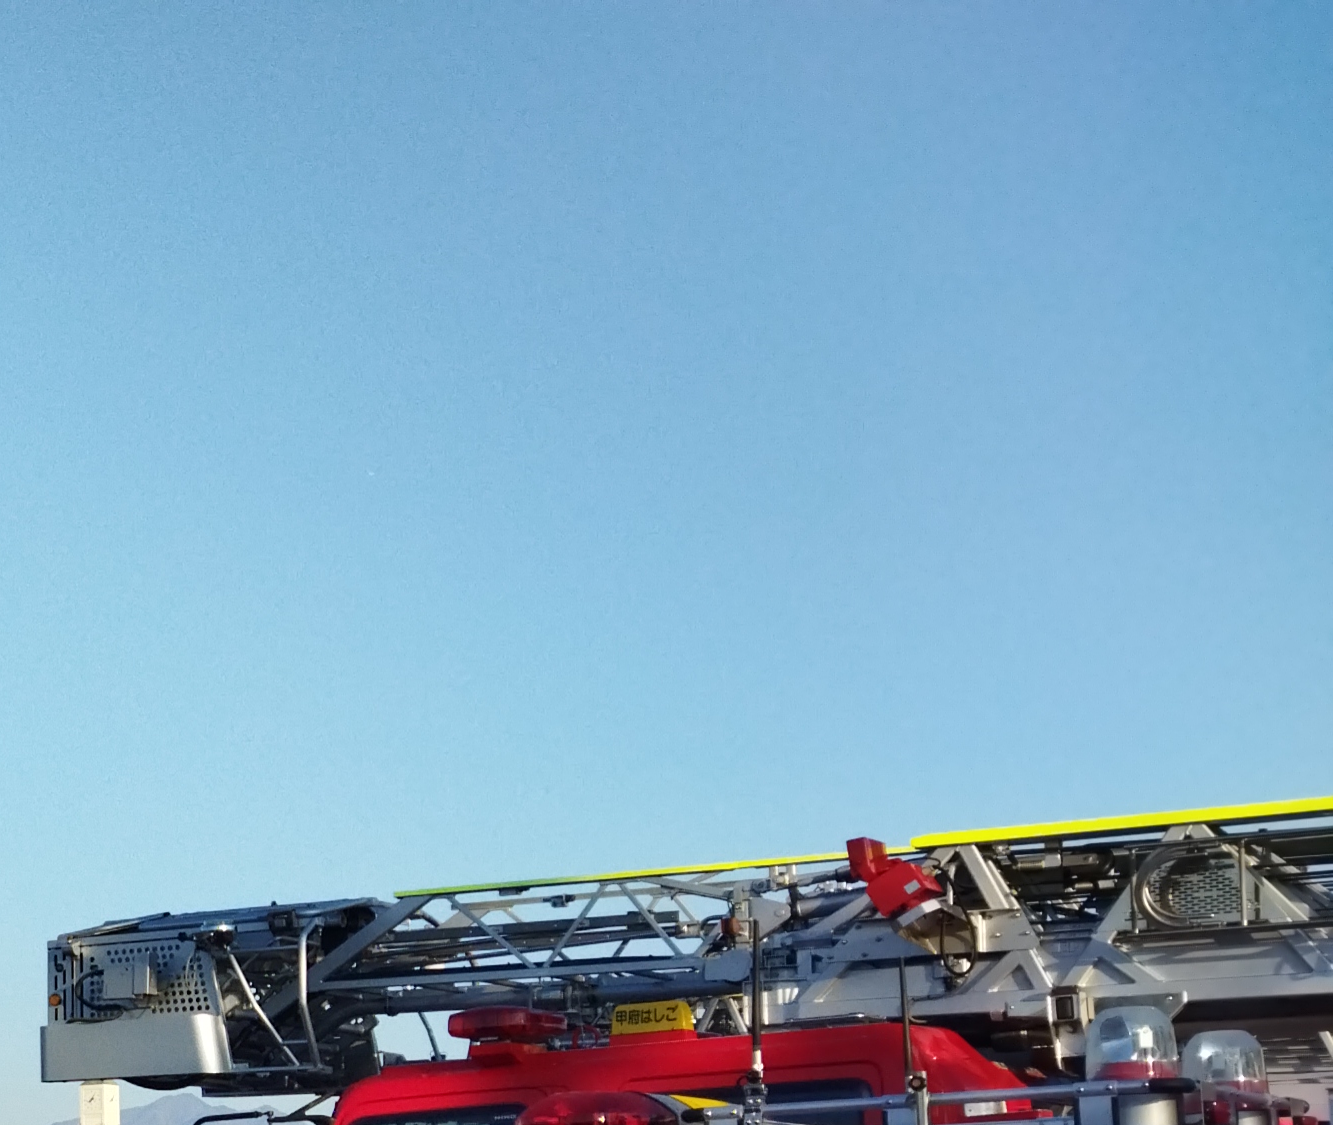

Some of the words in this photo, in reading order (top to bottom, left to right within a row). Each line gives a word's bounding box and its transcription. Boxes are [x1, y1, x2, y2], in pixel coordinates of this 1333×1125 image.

[615, 1004, 679, 1026] 甲府はしご
